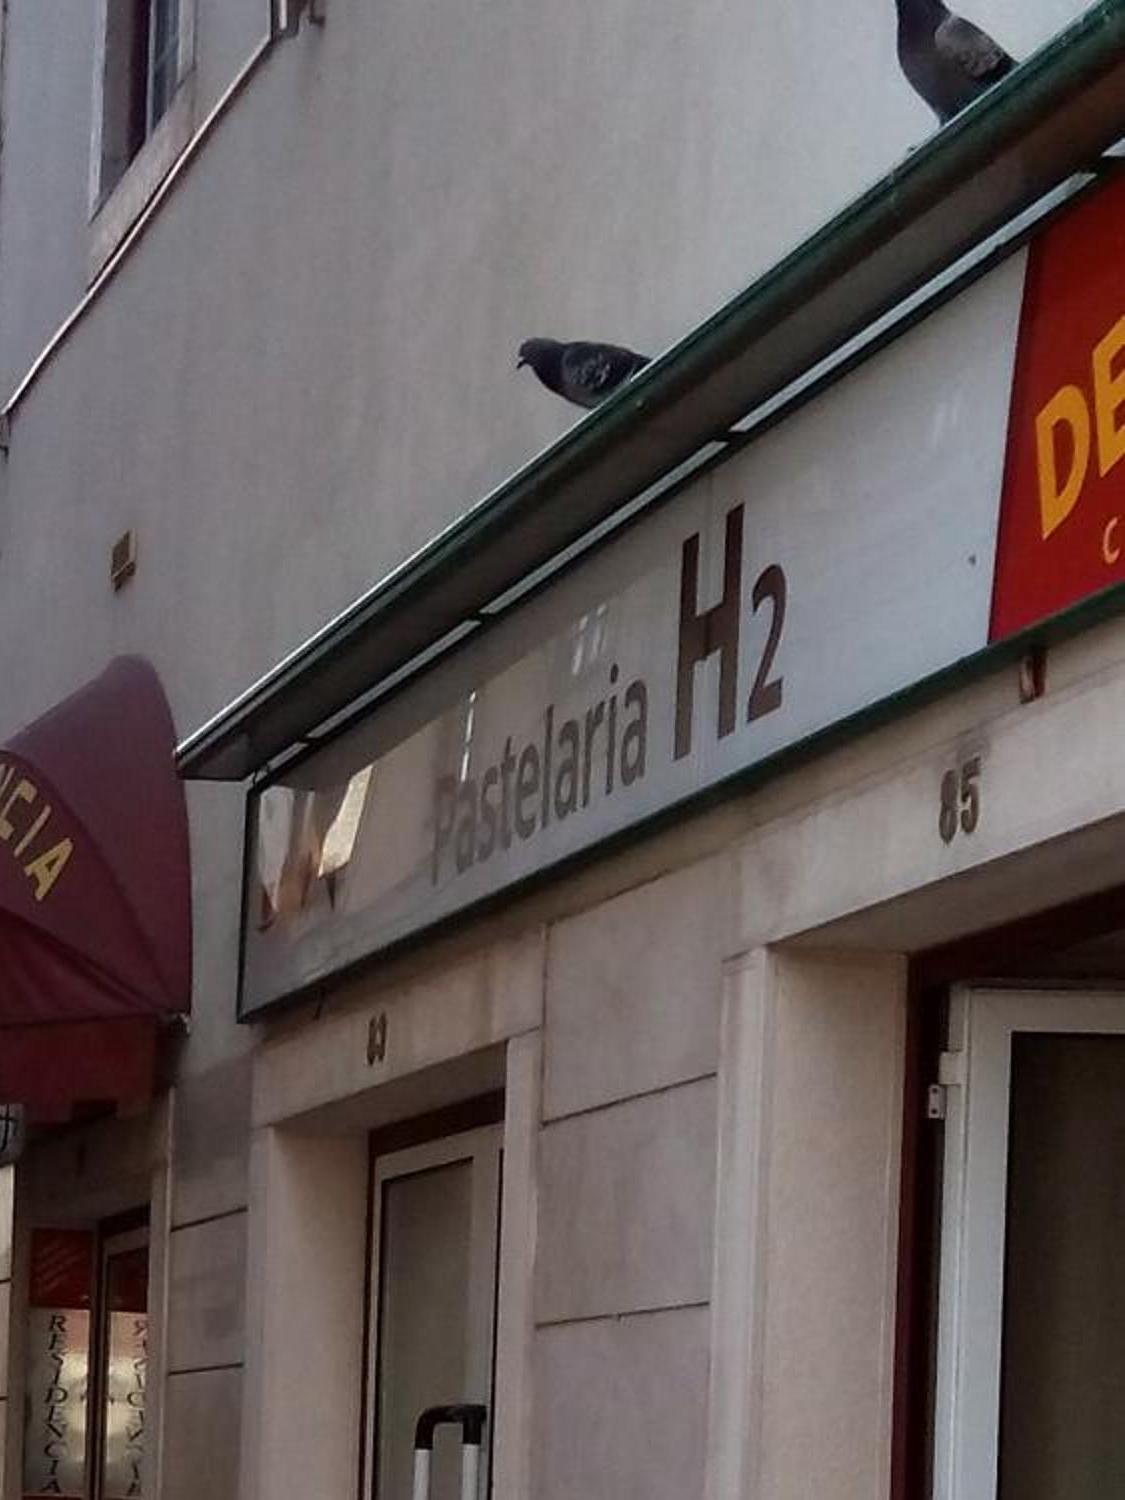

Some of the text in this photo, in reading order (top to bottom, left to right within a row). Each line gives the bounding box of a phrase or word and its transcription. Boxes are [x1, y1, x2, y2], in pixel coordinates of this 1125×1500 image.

[430, 502, 787, 887] Pastelaria H2
[938, 755, 981, 845] 85
